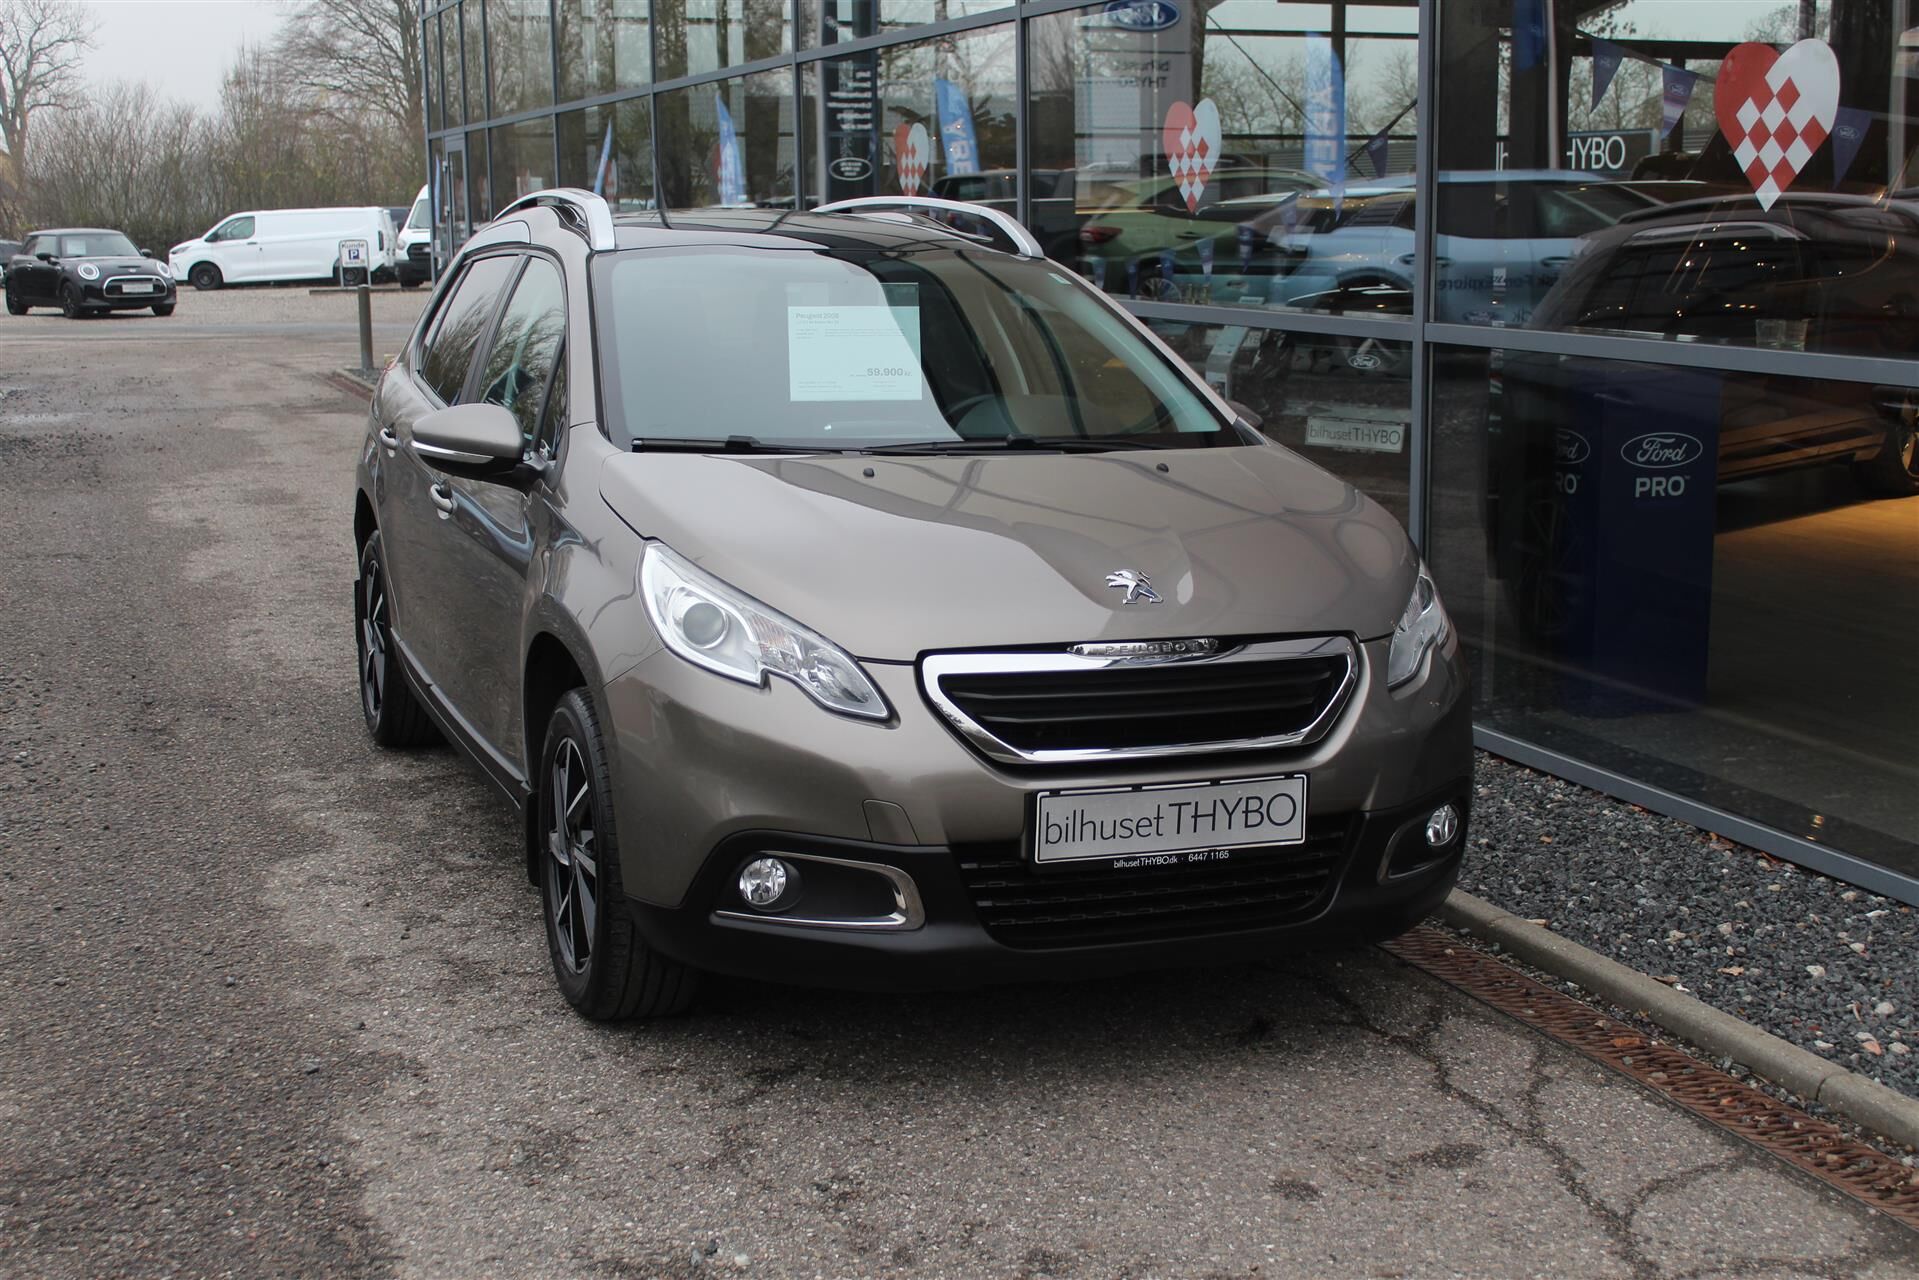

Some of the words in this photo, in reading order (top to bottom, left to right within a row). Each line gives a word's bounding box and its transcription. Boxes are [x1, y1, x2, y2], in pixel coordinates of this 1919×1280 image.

[867, 367, 904, 376] 59.900
[1636, 437, 1688, 463] Ford
[1188, 853, 1208, 862] 6447
[1210, 850, 1230, 861] 1165
